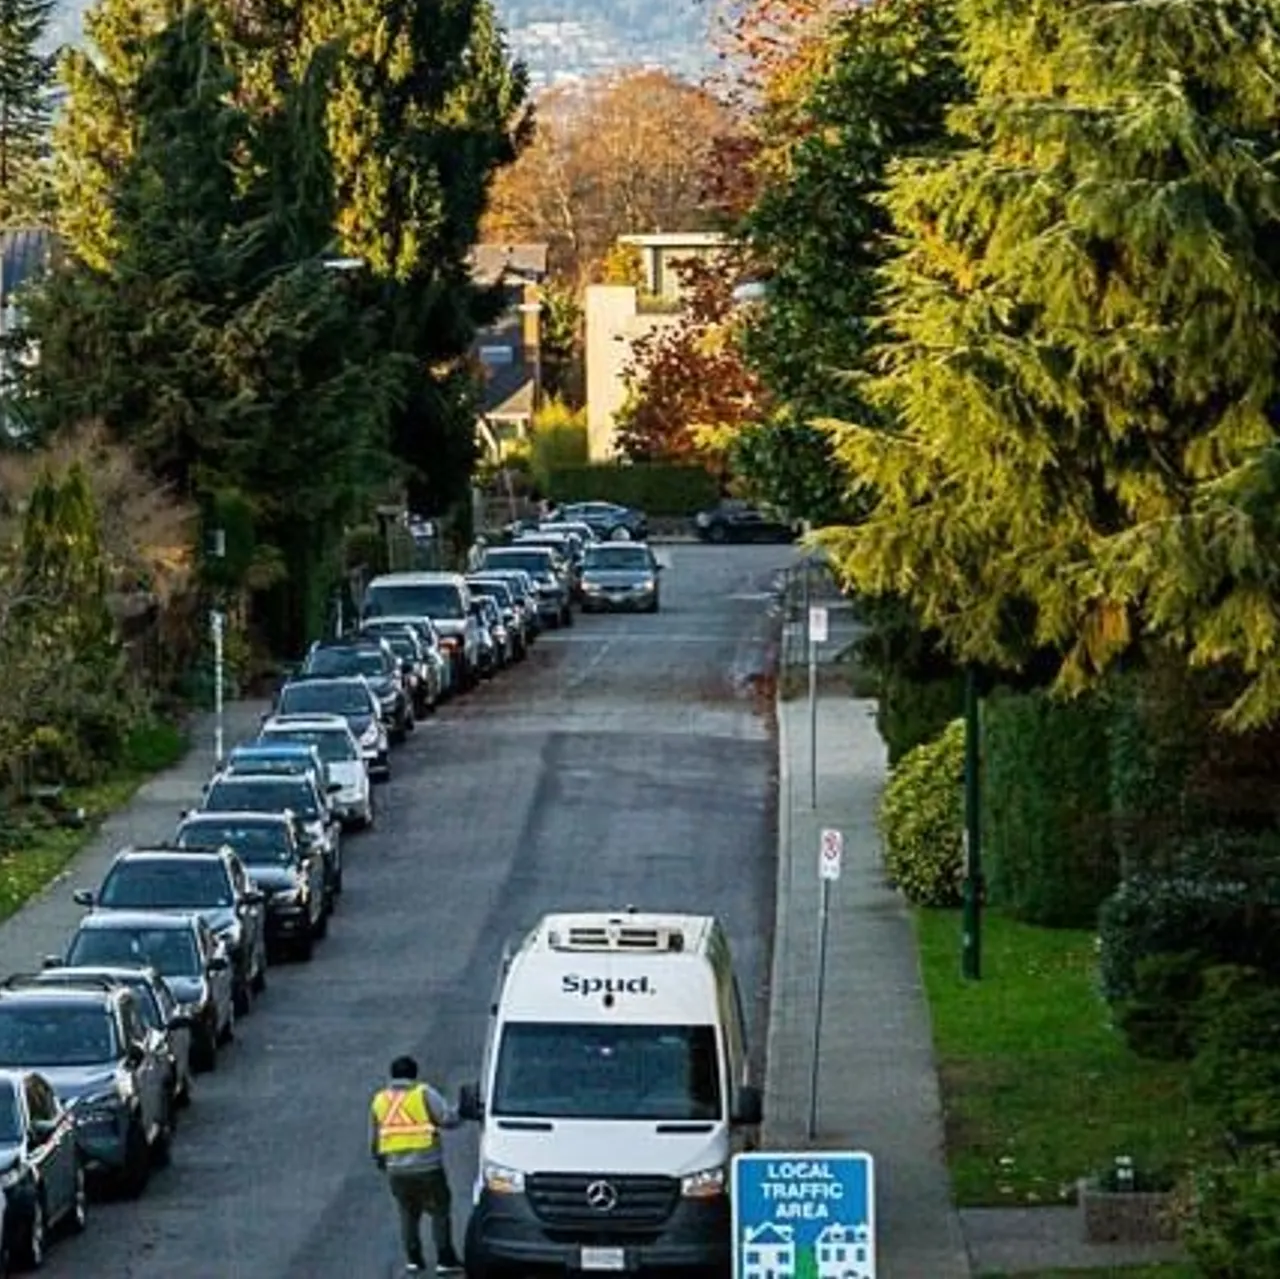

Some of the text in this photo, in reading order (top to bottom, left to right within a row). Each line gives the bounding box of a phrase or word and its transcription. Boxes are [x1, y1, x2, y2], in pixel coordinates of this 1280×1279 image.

[767, 1162, 834, 1179] LOCAL
[760, 1182, 844, 1200] TRAFFIC
[775, 1201, 829, 1218] AREA
